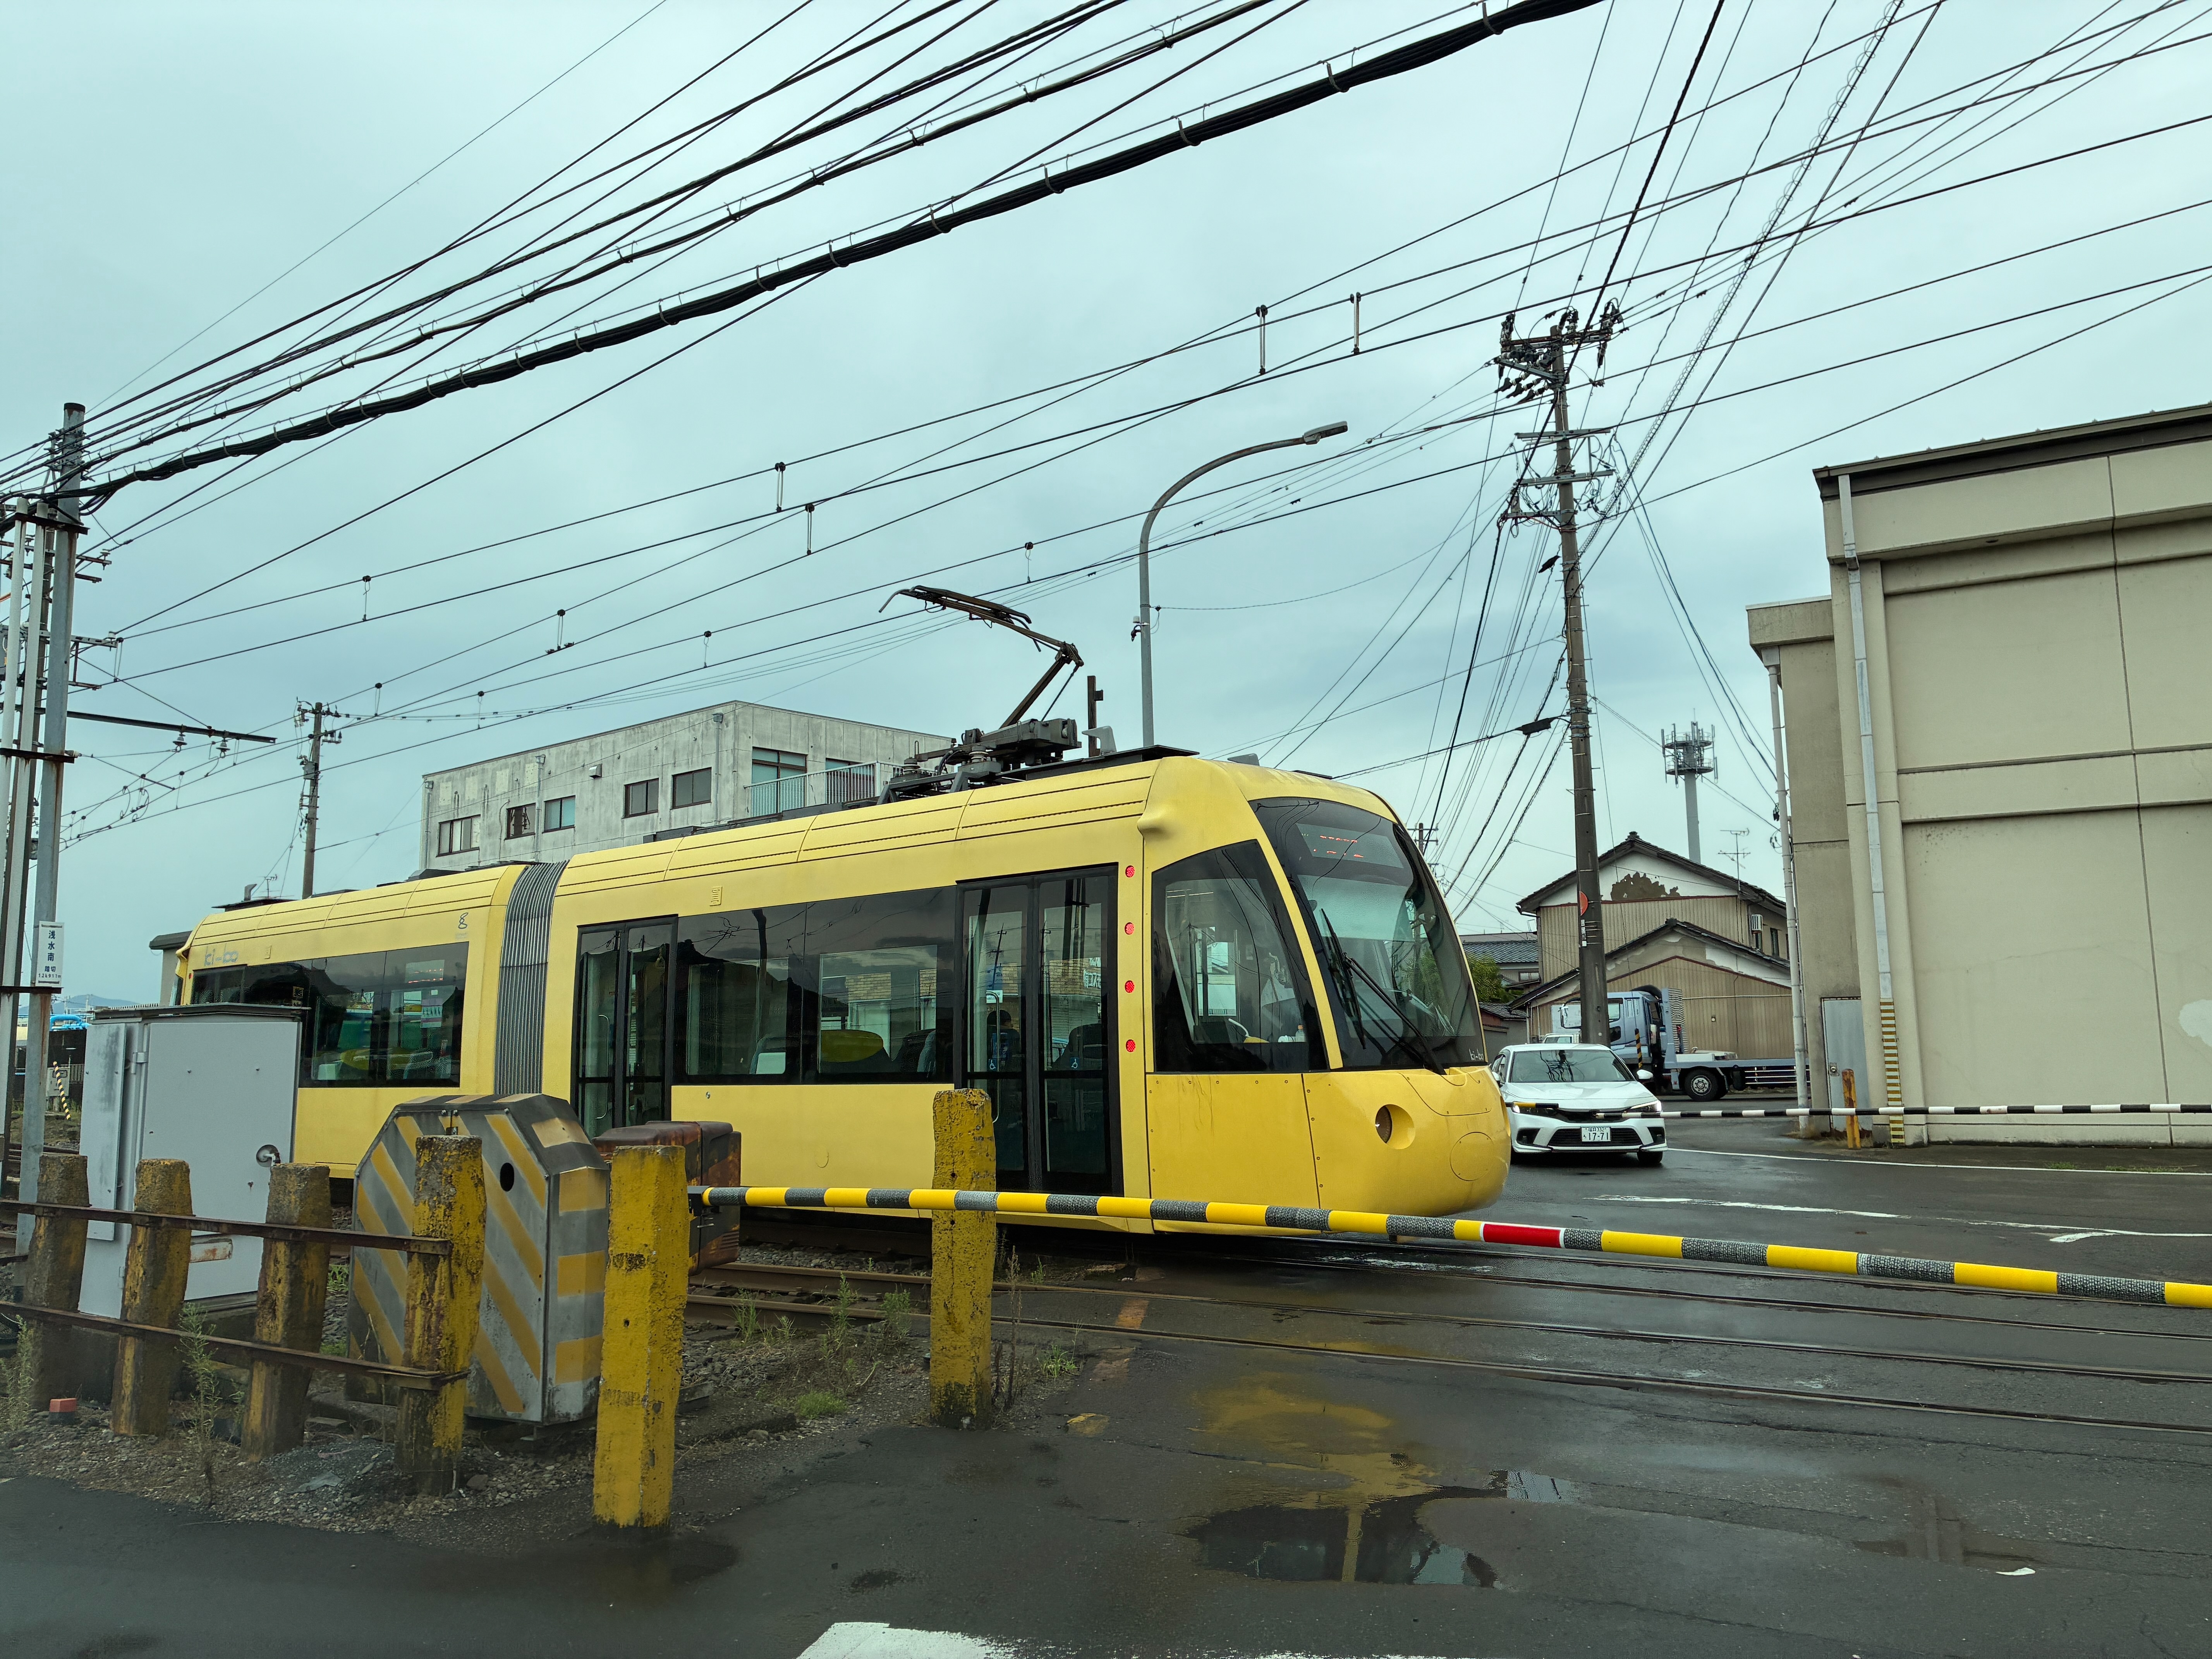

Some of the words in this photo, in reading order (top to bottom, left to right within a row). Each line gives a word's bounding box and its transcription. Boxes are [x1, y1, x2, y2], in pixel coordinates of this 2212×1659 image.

[47, 930, 56, 962] 浅水南
[1589, 1132, 1608, 1140] 17-71
